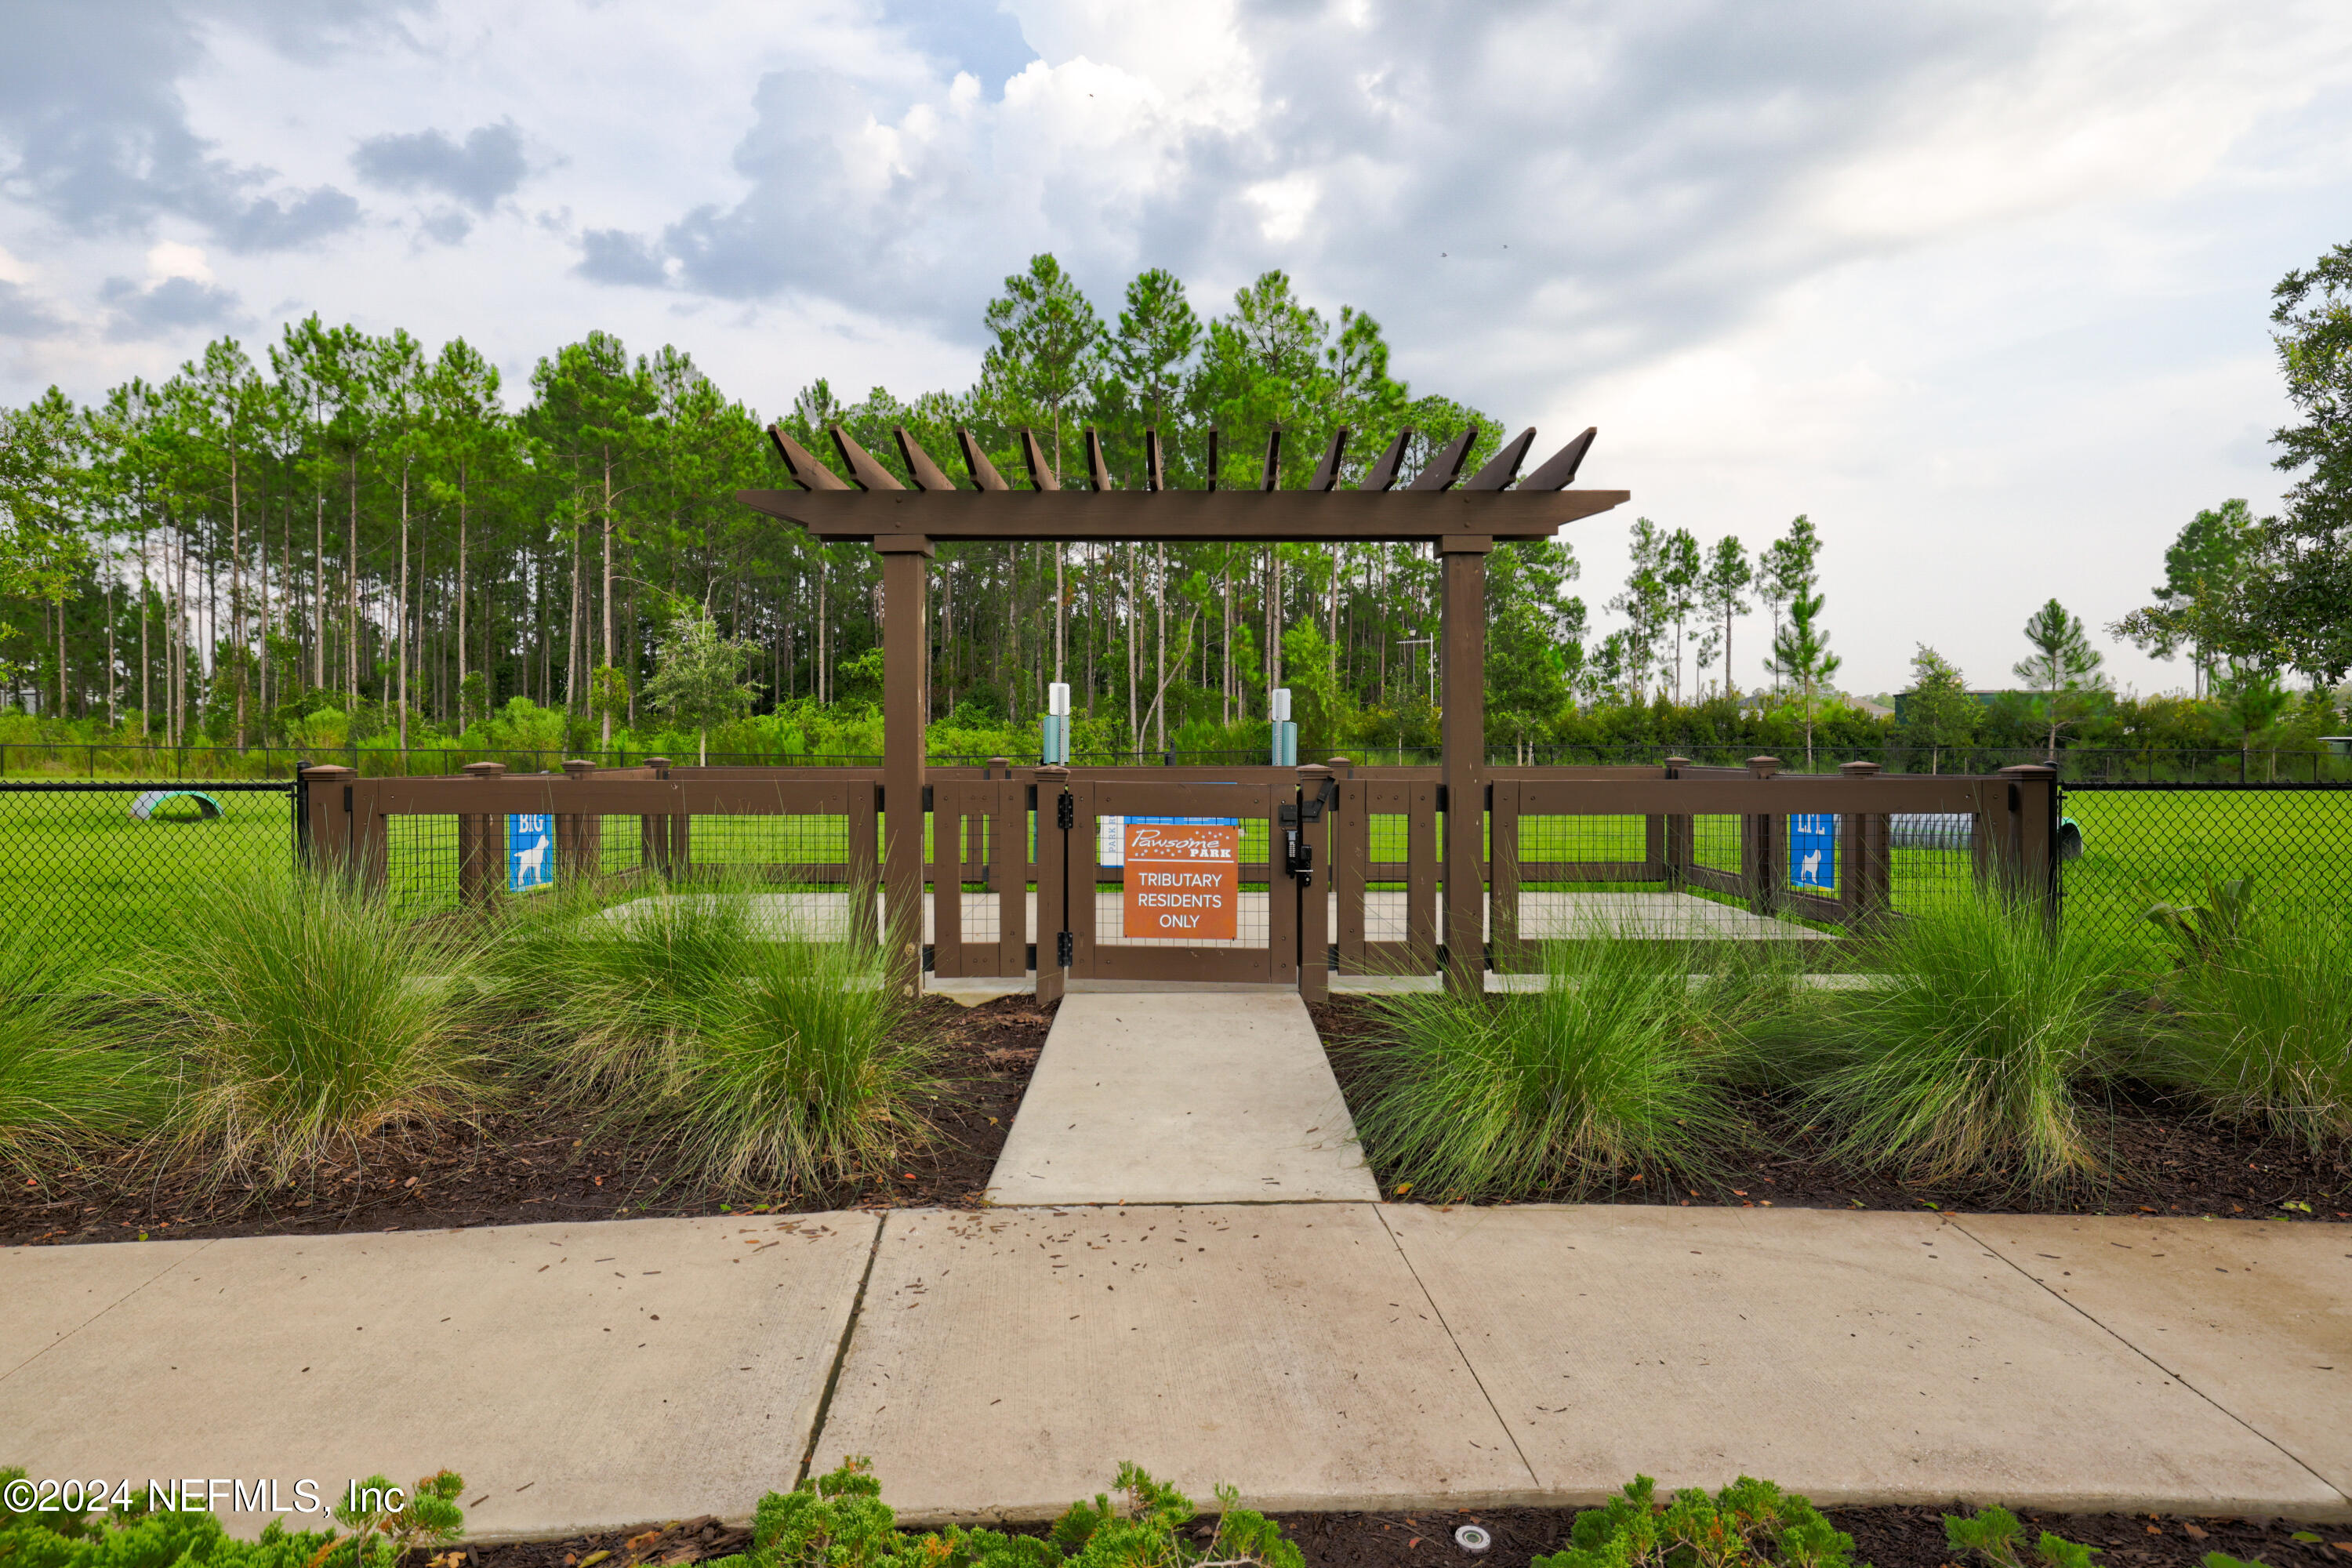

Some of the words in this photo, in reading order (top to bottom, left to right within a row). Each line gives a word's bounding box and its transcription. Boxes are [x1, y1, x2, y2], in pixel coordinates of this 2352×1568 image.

[519, 814, 544, 833] BIG
[1131, 829, 1220, 848] Pawsome
[1189, 848, 1231, 858] PARK
[1138, 873, 1222, 887] TRIBUTARY
[1138, 894, 1221, 908] RESIDENTS
[1160, 914, 1200, 928] ONLY
